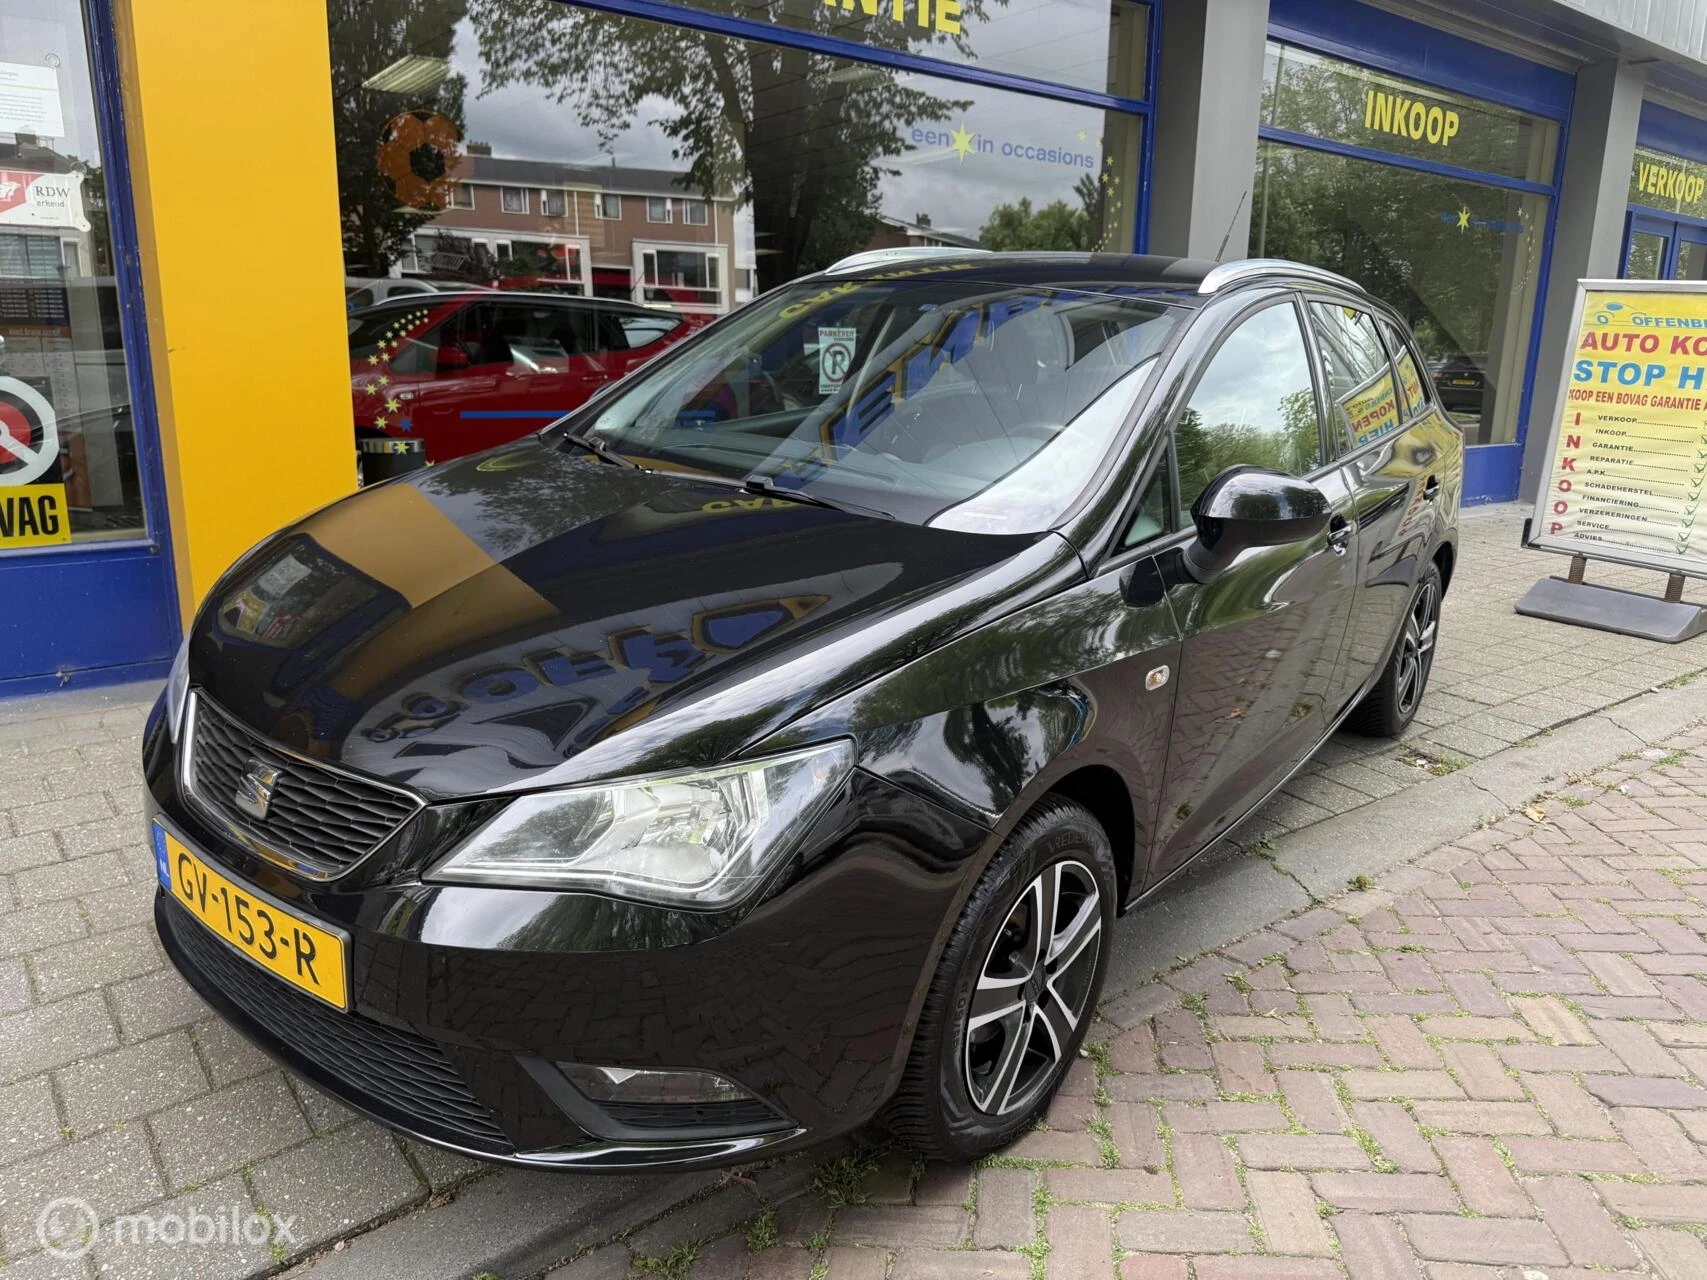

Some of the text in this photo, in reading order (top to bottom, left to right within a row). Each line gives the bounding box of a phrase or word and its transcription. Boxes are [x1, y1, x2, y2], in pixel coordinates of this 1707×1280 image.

[1365, 90, 1459, 146] INKOOP
[911, 127, 1094, 168] een in occasions
[1638, 161, 1705, 203] VERKOOP
[35, 186, 70, 198] RDW
[1631, 316, 1707, 328] OFFENB
[1580, 332, 1660, 354] AUTO
[1573, 360, 1666, 386] STOP
[1568, 389, 1594, 401] KOOP
[1595, 391, 1614, 404] EEN
[1616, 393, 1648, 408] BOVAG
[1650, 395, 1702, 411] GARANTIE
[1597, 415, 1638, 424] VERKOOP
[1595, 428, 1627, 437] INKOOP
[1592, 442, 1634, 452] GARANTIE
[1589, 455, 1634, 466] REPARATIE
[1584, 482, 1654, 496] SCHADEHERSTEL
[1582, 494, 1640, 508] FINANCIERING
[1579, 507, 1648, 522] VERZEKERINGEN
[1576, 520, 1611, 531] SERVICE
[1573, 532, 1604, 542] ADVIES
[159, 860, 170, 878] NL
[177, 852, 321, 986] GV-153-R
